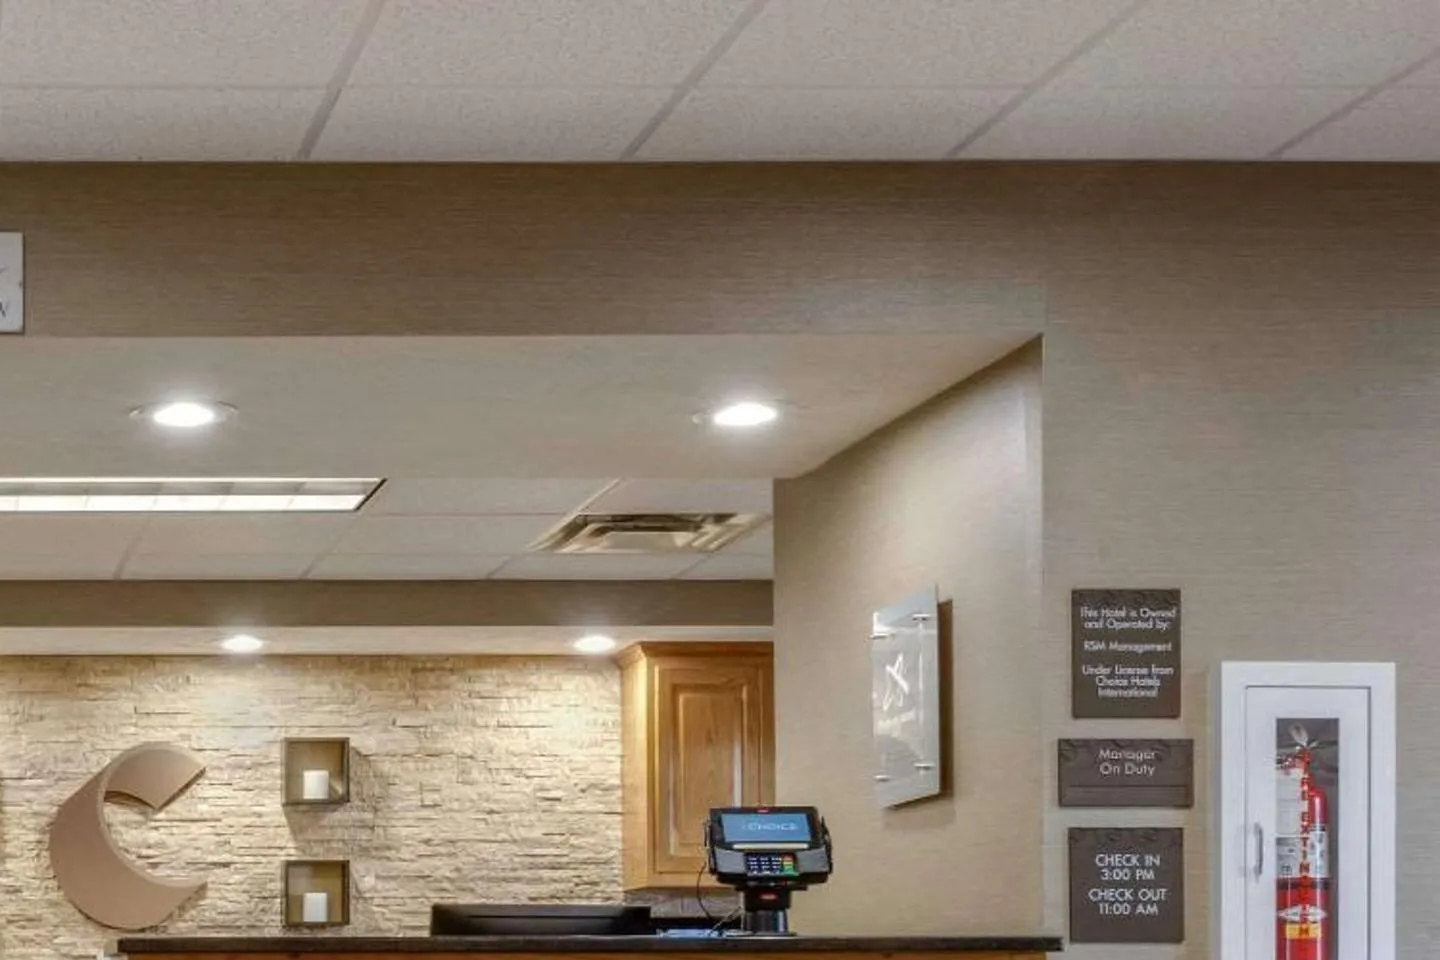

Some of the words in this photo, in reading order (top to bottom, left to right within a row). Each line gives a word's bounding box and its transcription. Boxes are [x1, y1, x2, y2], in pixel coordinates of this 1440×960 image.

[1101, 606, 1126, 618] Hotel
[1140, 607, 1176, 618] Owned
[1084, 619, 1104, 629] and
[1106, 618, 1153, 631] Operated
[1109, 640, 1172, 653] Management
[1082, 664, 1112, 675] Under
[1115, 664, 1148, 675] License
[1151, 664, 1174, 675] from
[1096, 675, 1128, 686] Choice
[1131, 675, 1160, 687] Hotels
[1098, 687, 1158, 698] International
[1099, 749, 1155, 762] Manager
[1100, 762, 1120, 775] On
[1124, 762, 1155, 776] Duty
[1095, 854, 1140, 867] CHECK
[1145, 854, 1161, 867] IN
[1100, 869, 1130, 880] 3:00
[1135, 869, 1155, 881] PM
[1088, 888, 1134, 901] CHECK
[1138, 888, 1168, 901] OUT
[1098, 903, 1130, 915] 11:00
[1135, 903, 1158, 915] AM
